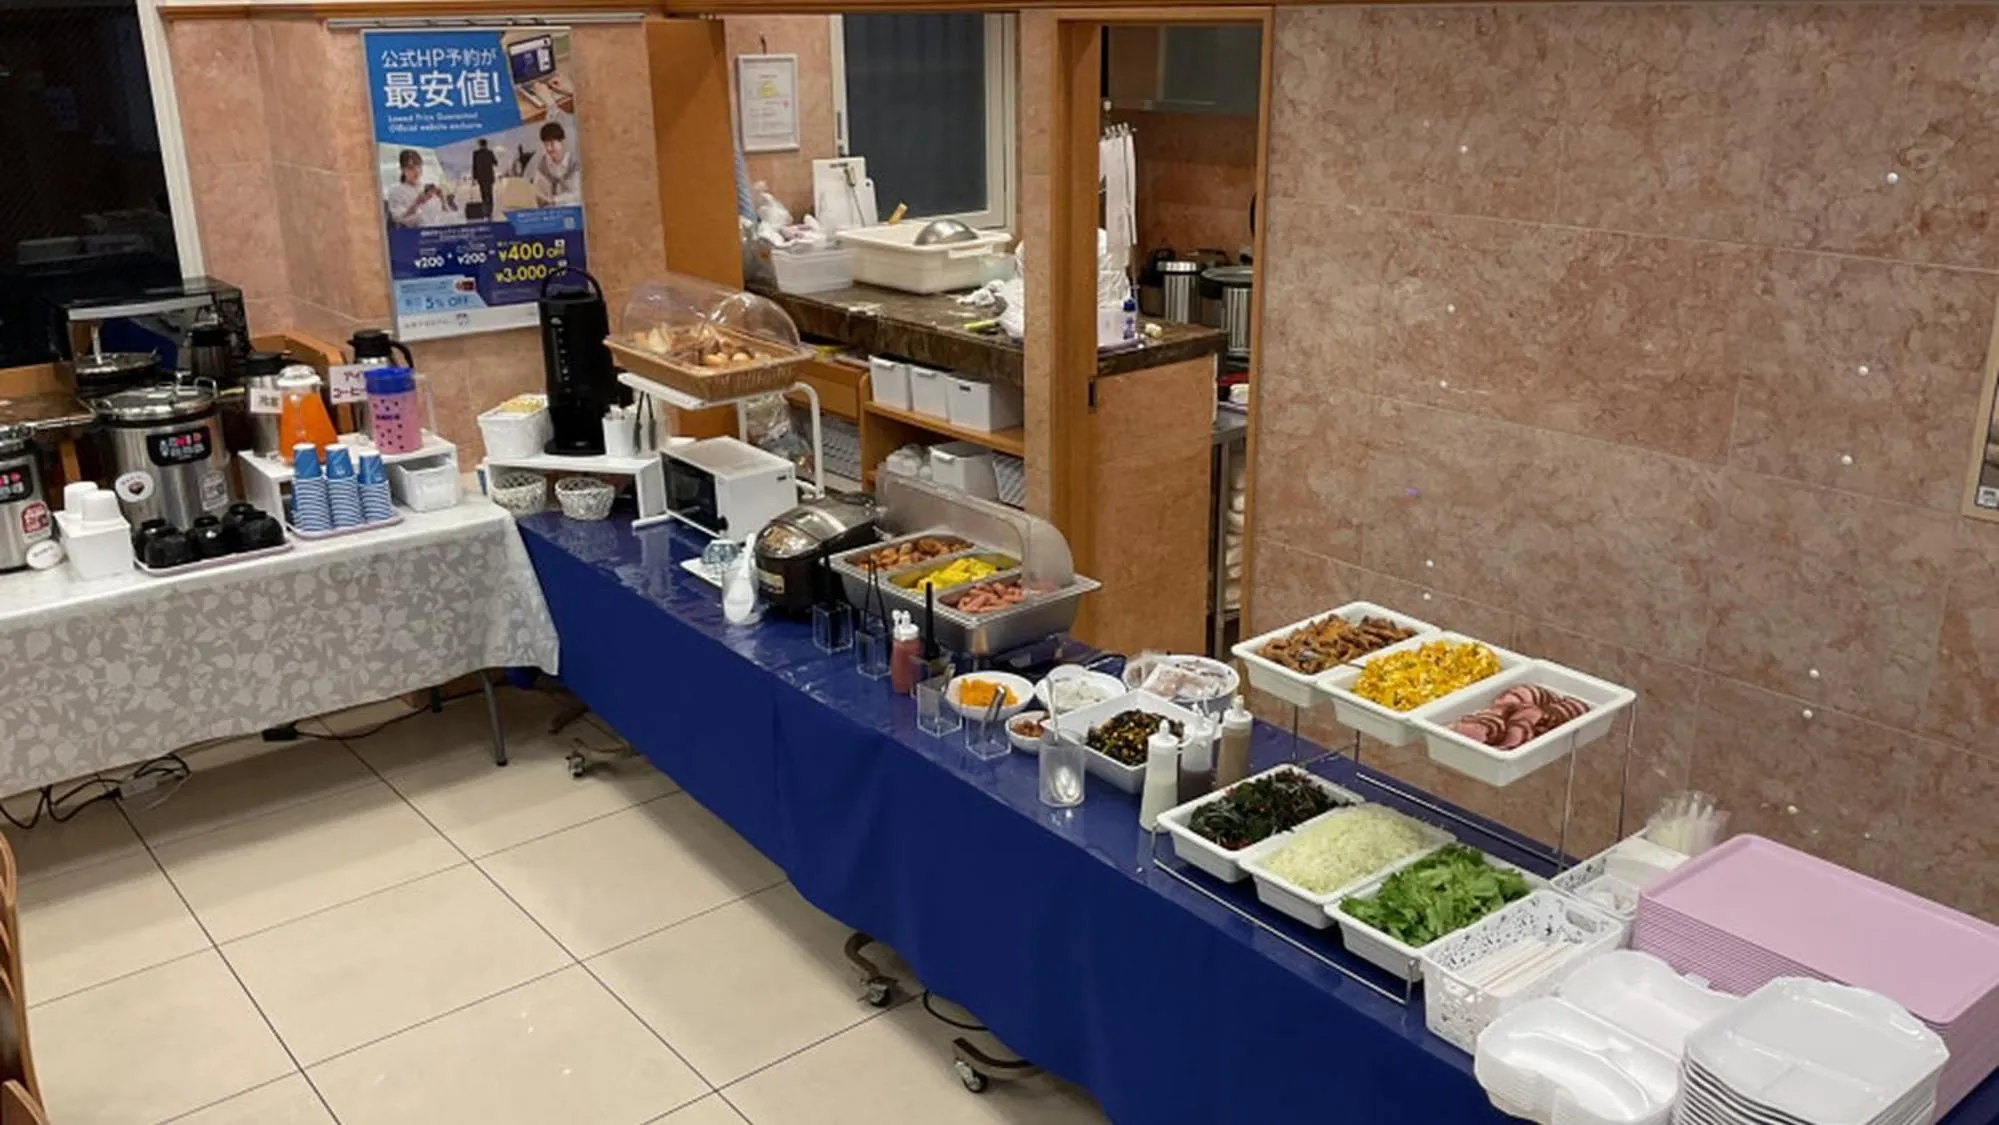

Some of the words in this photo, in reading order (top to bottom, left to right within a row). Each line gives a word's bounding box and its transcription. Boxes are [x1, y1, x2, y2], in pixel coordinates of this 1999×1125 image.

[381, 48, 497, 68] 公式HP予約が
[383, 70, 501, 108] 最安値!
